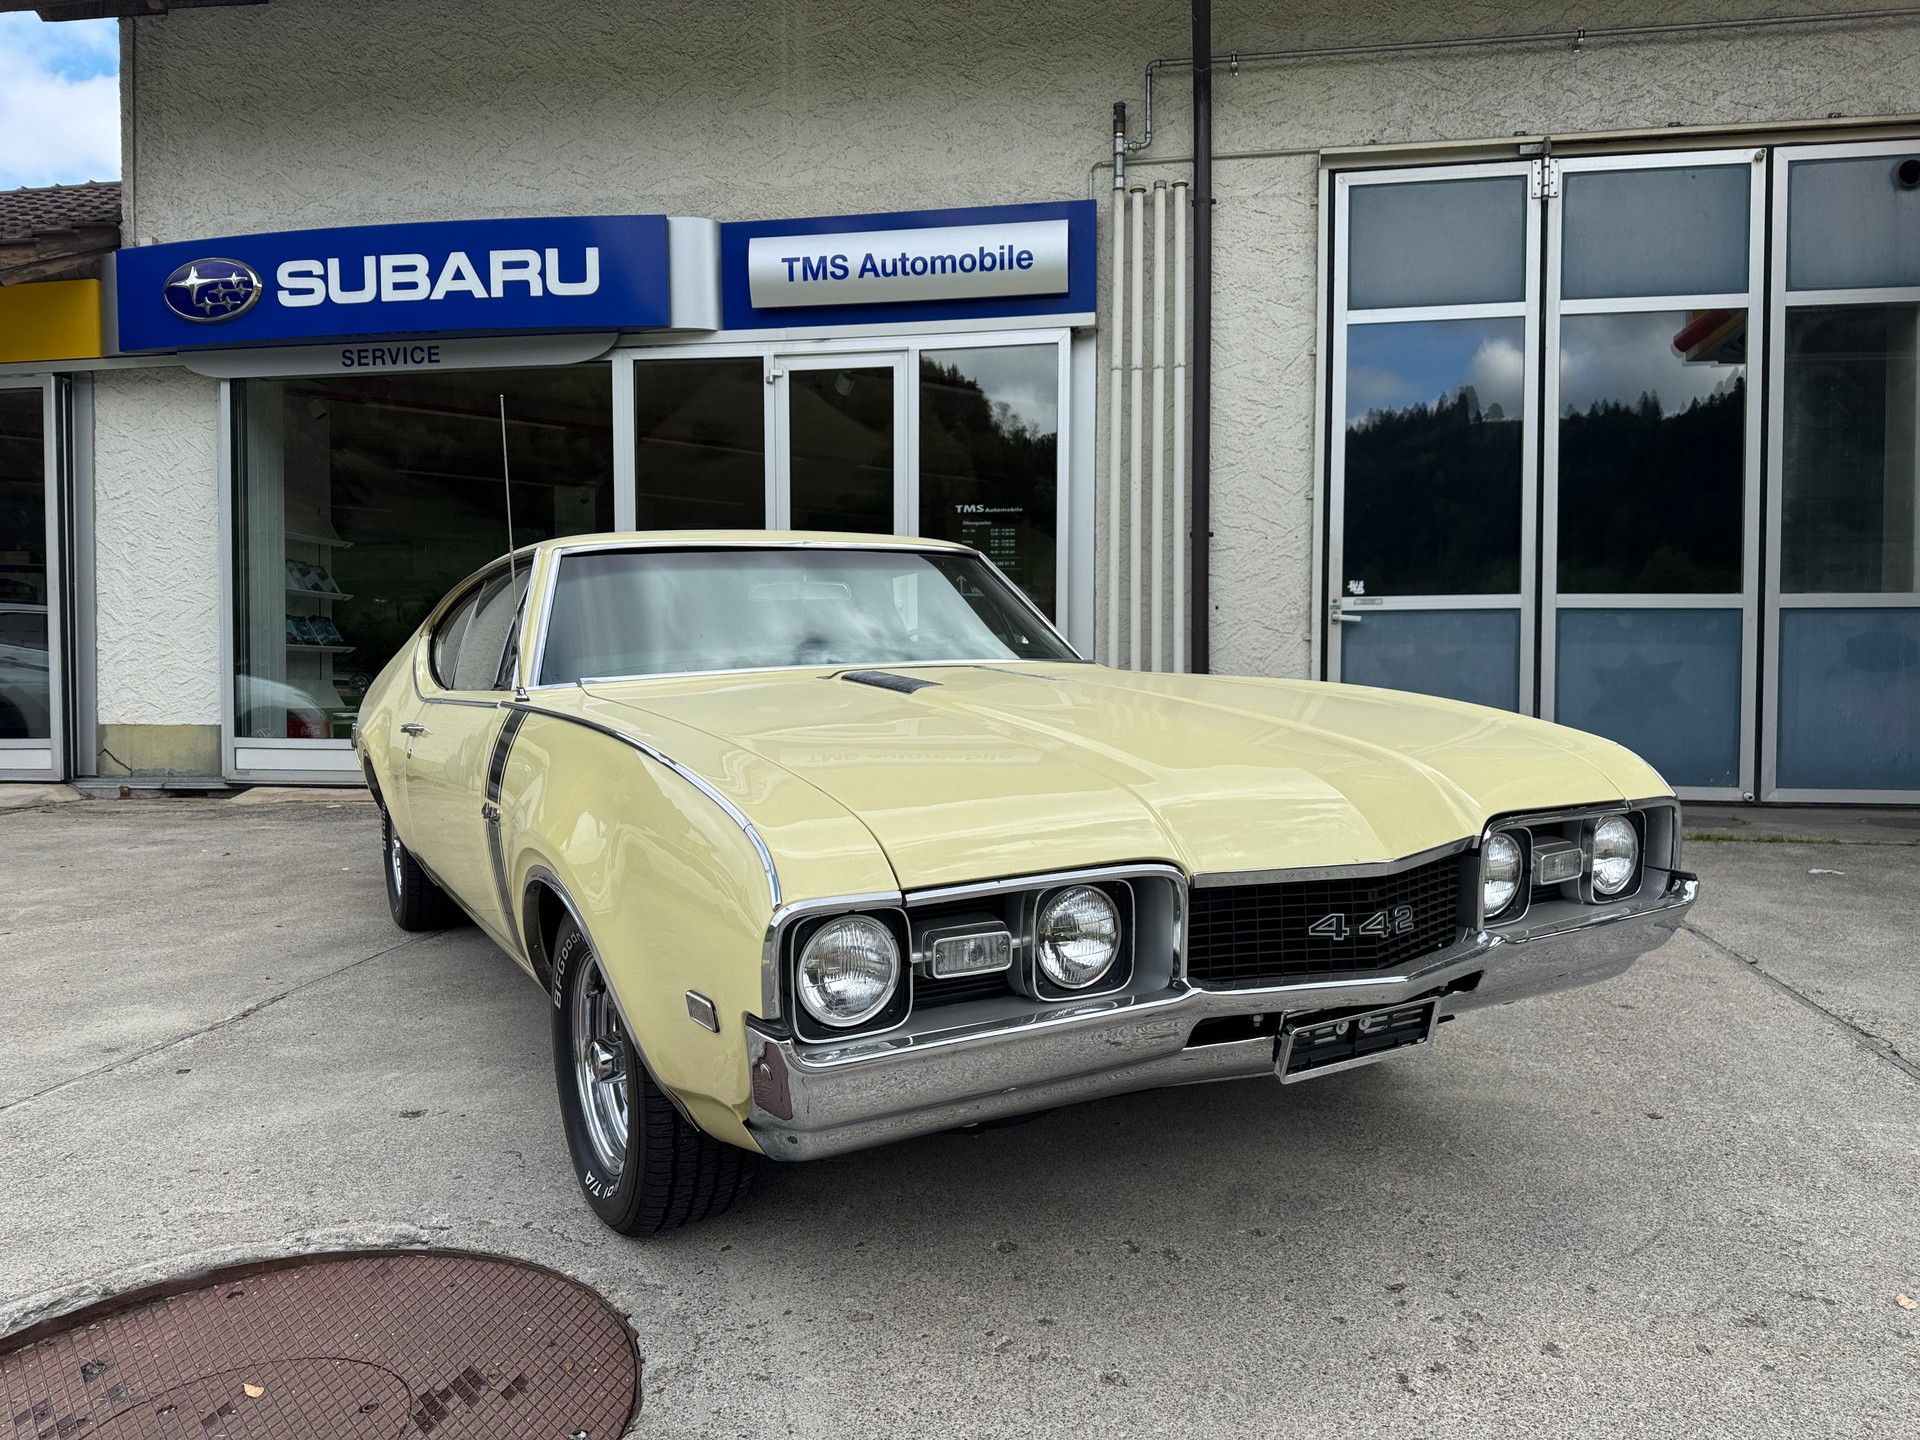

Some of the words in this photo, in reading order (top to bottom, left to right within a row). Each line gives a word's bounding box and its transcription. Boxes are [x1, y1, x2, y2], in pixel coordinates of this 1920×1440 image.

[276, 247, 600, 307] SUBARU
[781, 254, 850, 282] TMS
[858, 244, 1034, 278] Automobile
[341, 345, 441, 368] SERVICE
[955, 504, 984, 513] TMS
